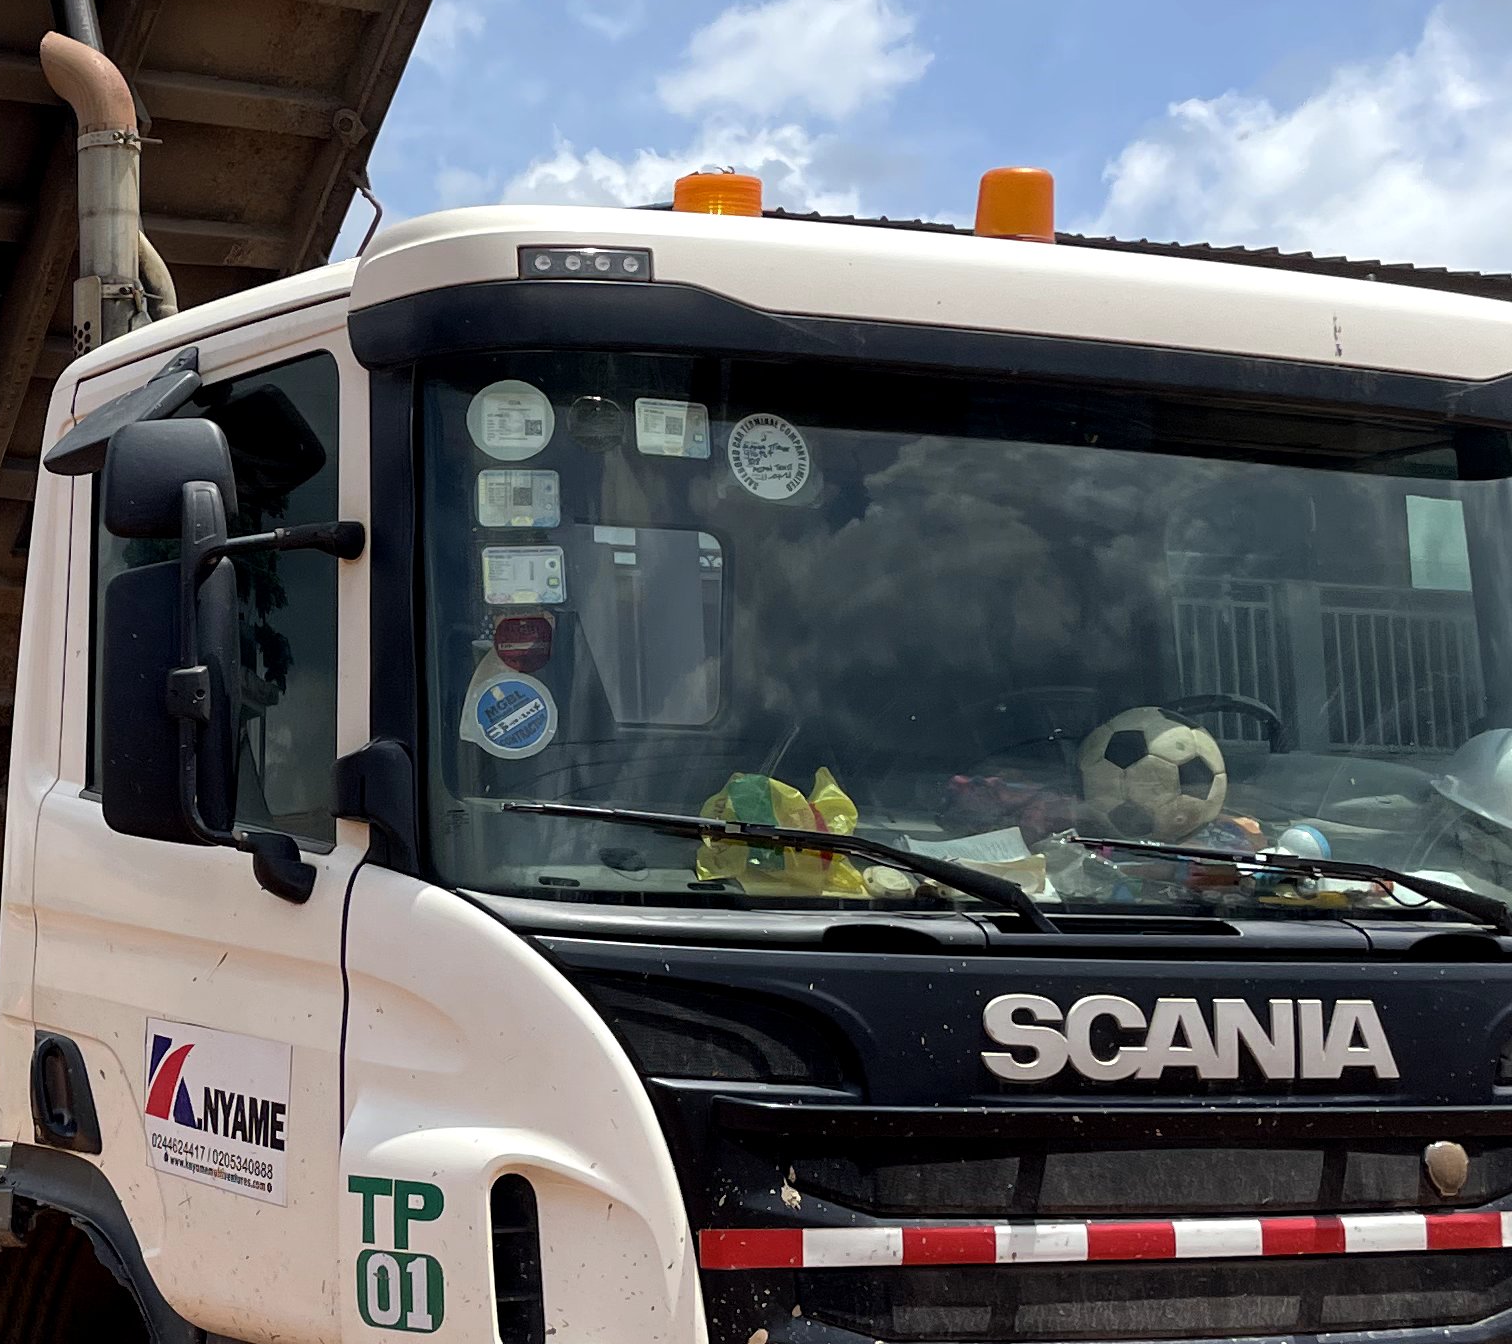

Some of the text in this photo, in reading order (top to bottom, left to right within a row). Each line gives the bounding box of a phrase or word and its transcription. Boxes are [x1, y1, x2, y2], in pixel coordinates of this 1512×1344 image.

[741, 418, 778, 433] TERMINAL
[779, 424, 807, 462] COMPANY
[786, 462, 807, 492] LIMITED
[981, 993, 1400, 1082] SCANIA
[151, 1132, 206, 1159] 0244624417
[212, 1149, 273, 1180] 0205340888
[348, 1175, 444, 1250] TP
[366, 1253, 433, 1330] 01
